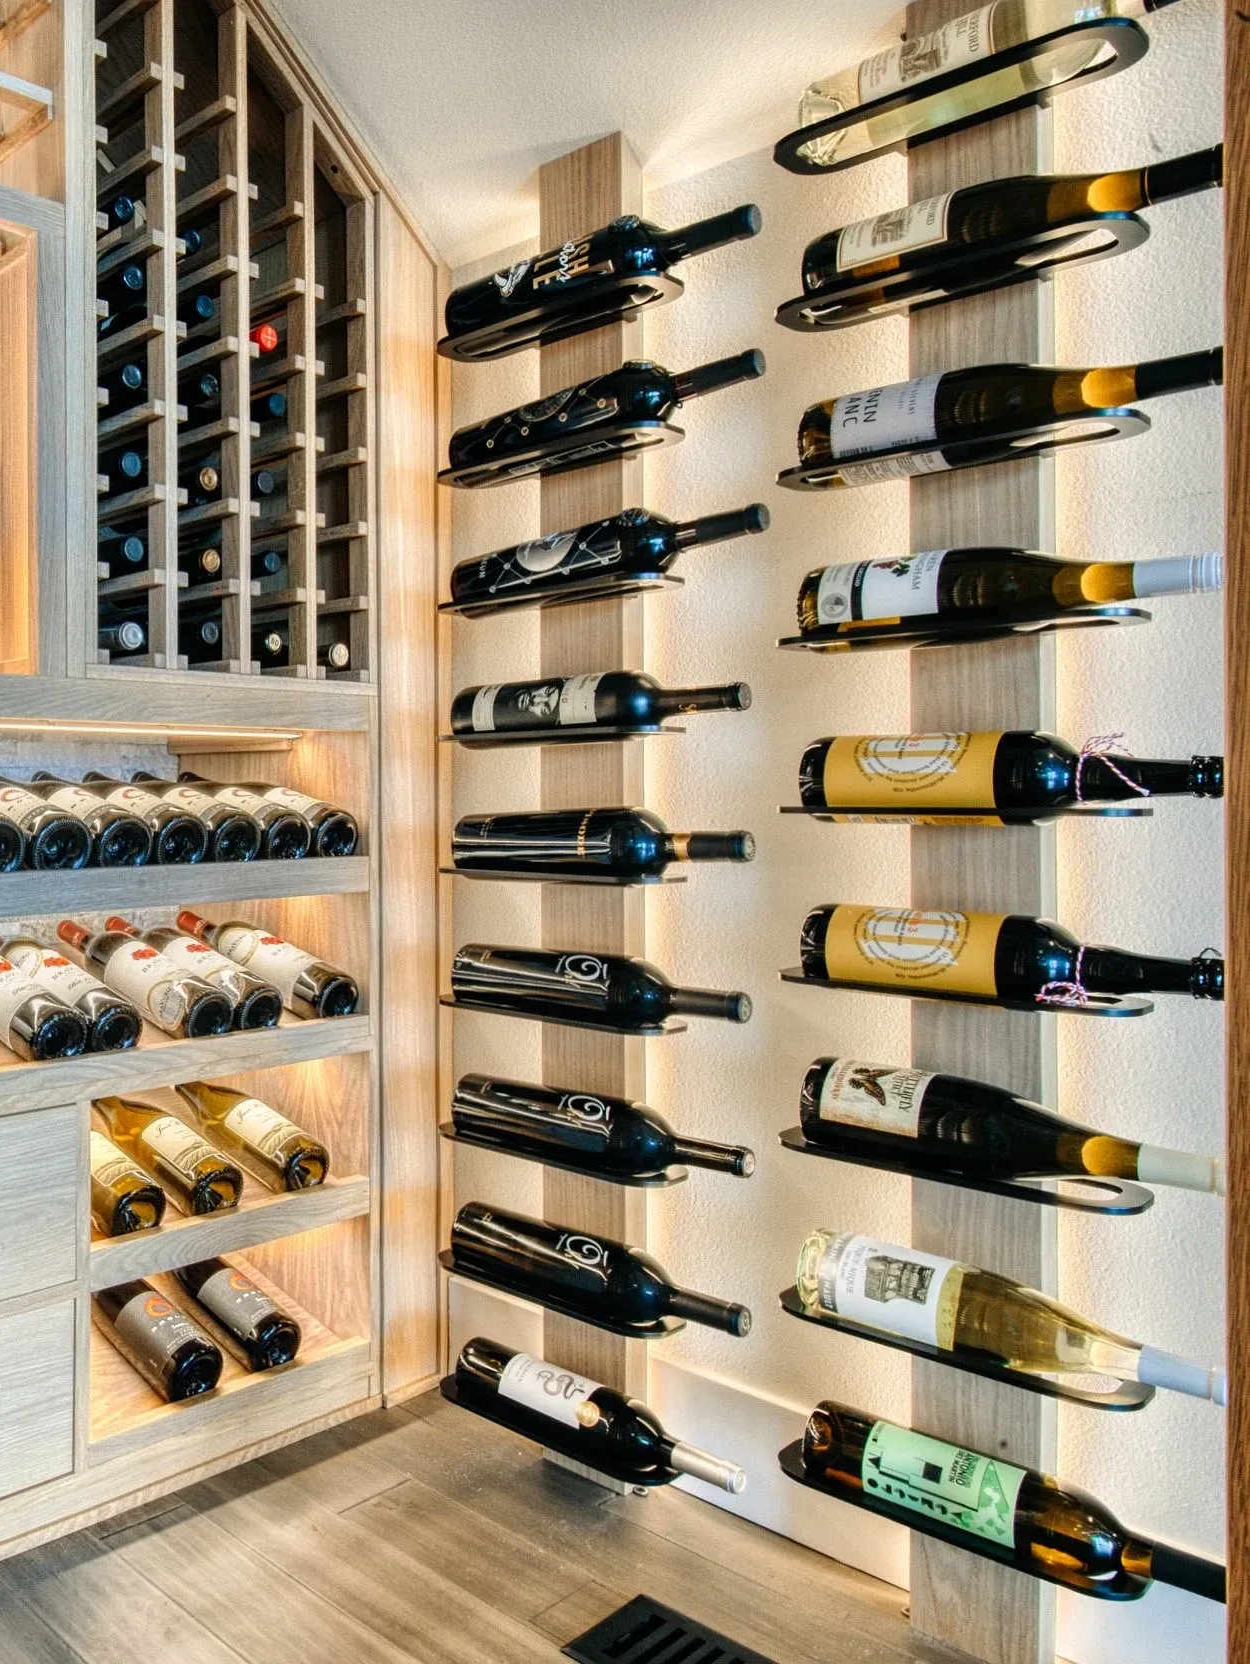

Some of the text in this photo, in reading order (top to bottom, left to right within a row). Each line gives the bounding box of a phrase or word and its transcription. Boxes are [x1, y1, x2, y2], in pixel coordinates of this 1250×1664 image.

[968, 11, 980, 52] ERFORD
[842, 396, 858, 428] ANC
[863, 388, 880, 422] ENIN
